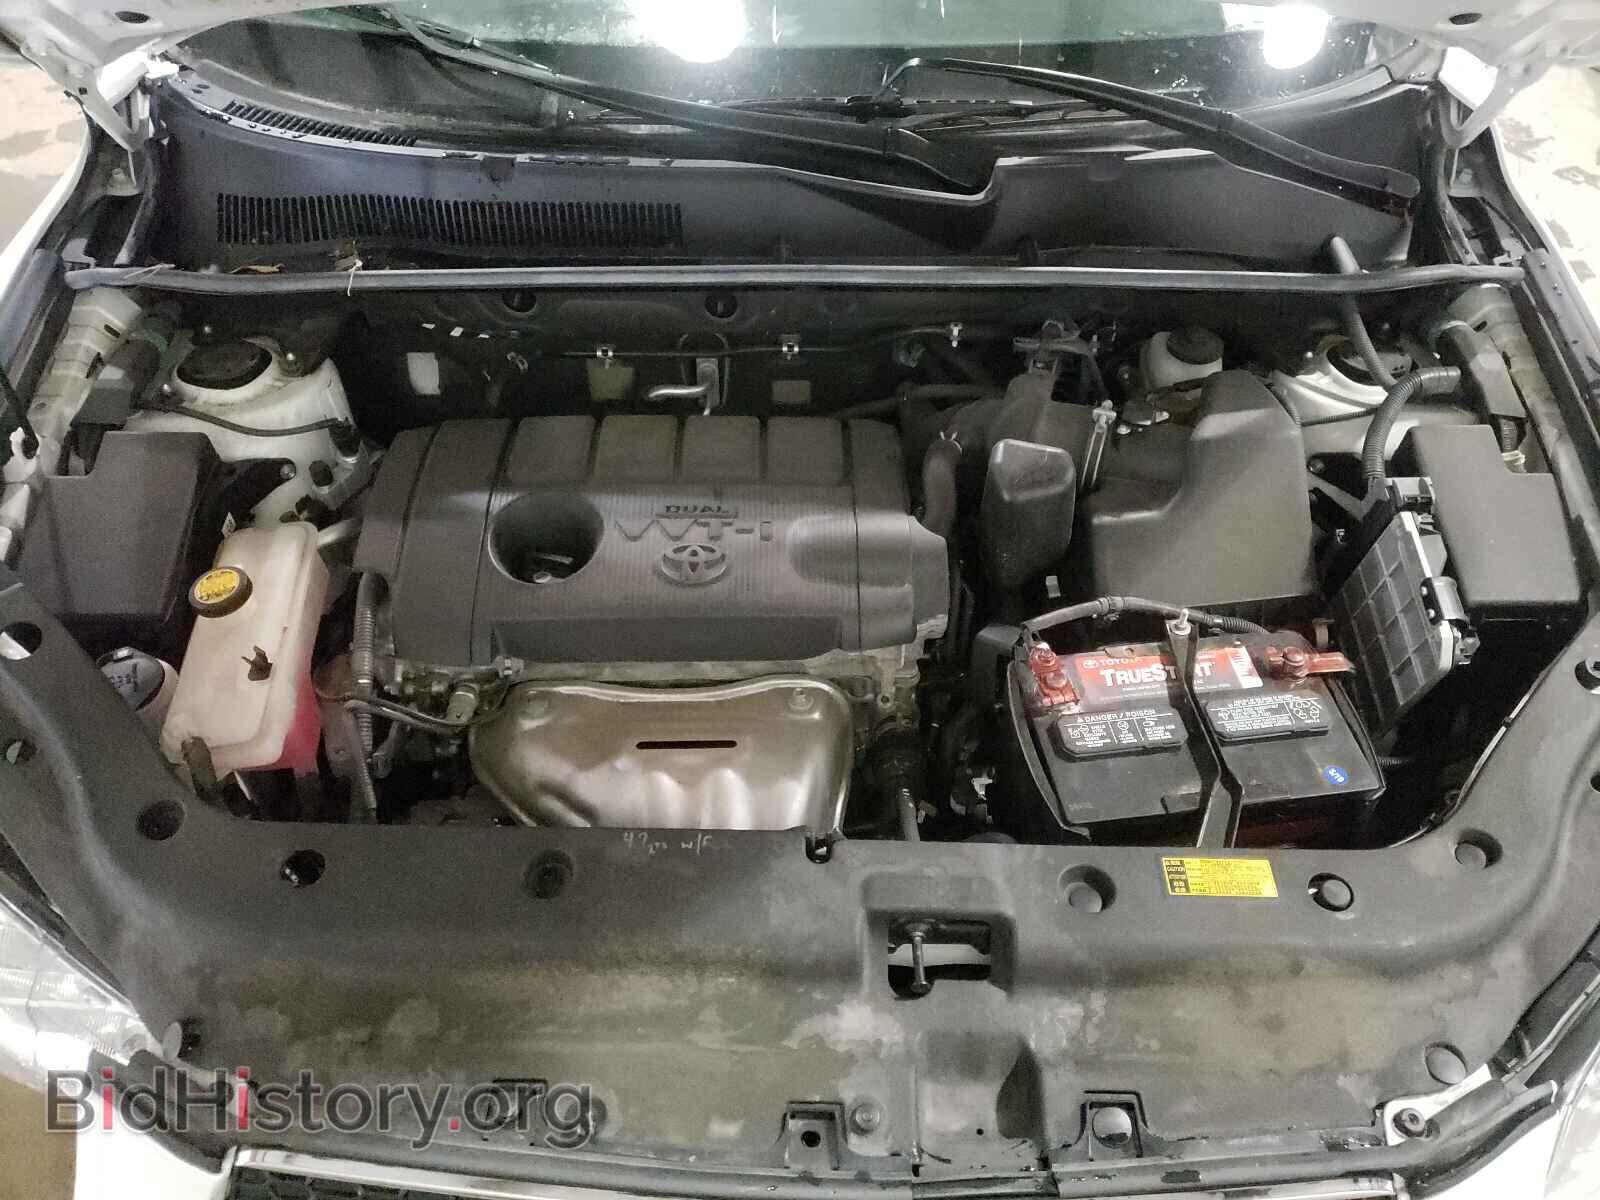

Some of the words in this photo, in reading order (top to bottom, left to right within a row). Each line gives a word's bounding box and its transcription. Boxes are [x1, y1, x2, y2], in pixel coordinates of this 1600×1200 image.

[665, 504, 729, 514] DUAL
[1084, 712, 1119, 723] DANGER
[1125, 708, 1157, 718] POISON
